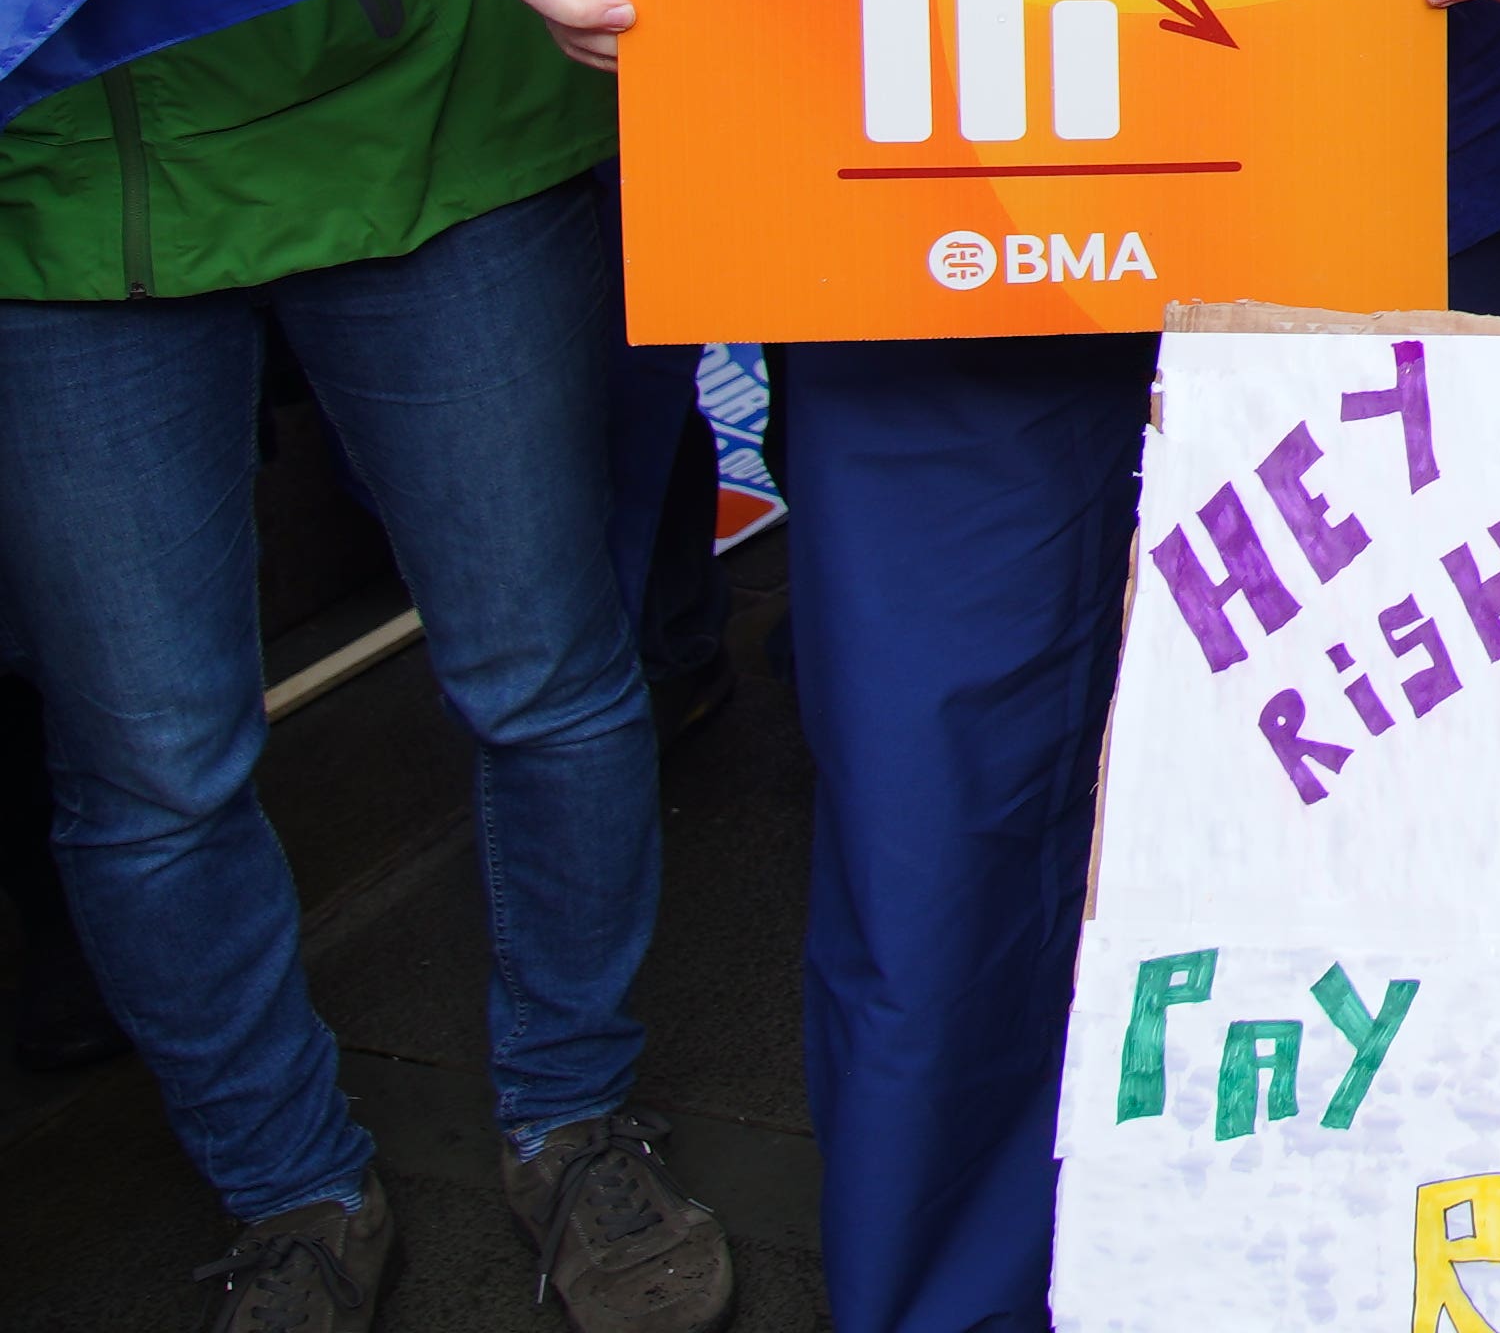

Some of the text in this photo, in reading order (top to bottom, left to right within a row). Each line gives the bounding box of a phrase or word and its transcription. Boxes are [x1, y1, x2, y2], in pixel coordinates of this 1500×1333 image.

[1003, 231, 1158, 284] BMA
[1149, 340, 1442, 673] HEY
[1117, 947, 1421, 1140] PAY
